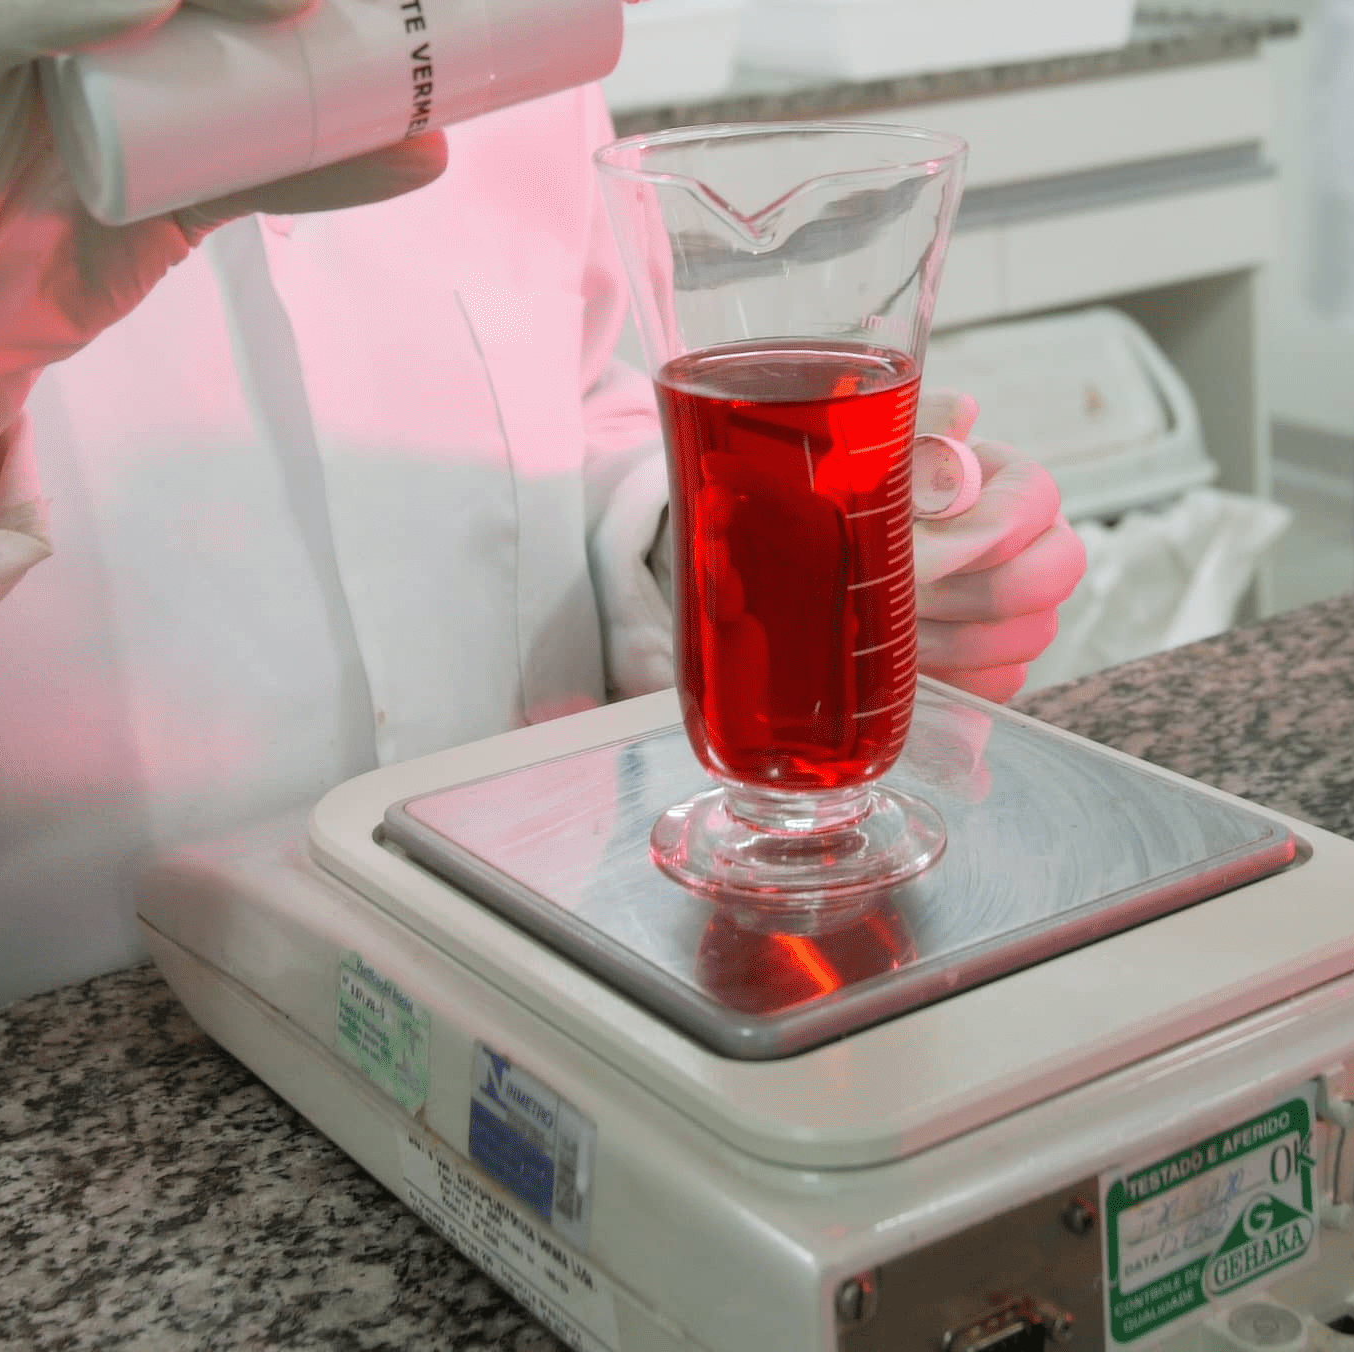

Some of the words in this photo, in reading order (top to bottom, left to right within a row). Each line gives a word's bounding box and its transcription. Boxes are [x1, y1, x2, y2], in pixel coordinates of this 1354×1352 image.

[1127, 1152, 1203, 1200] TESTADO
[1206, 1143, 1218, 1163] E
[1221, 1111, 1291, 1155] AFERIDO
[1270, 1130, 1316, 1185] OK
[1123, 1254, 1161, 1277] DATA
[1212, 1221, 1305, 1288] GEHAKA
